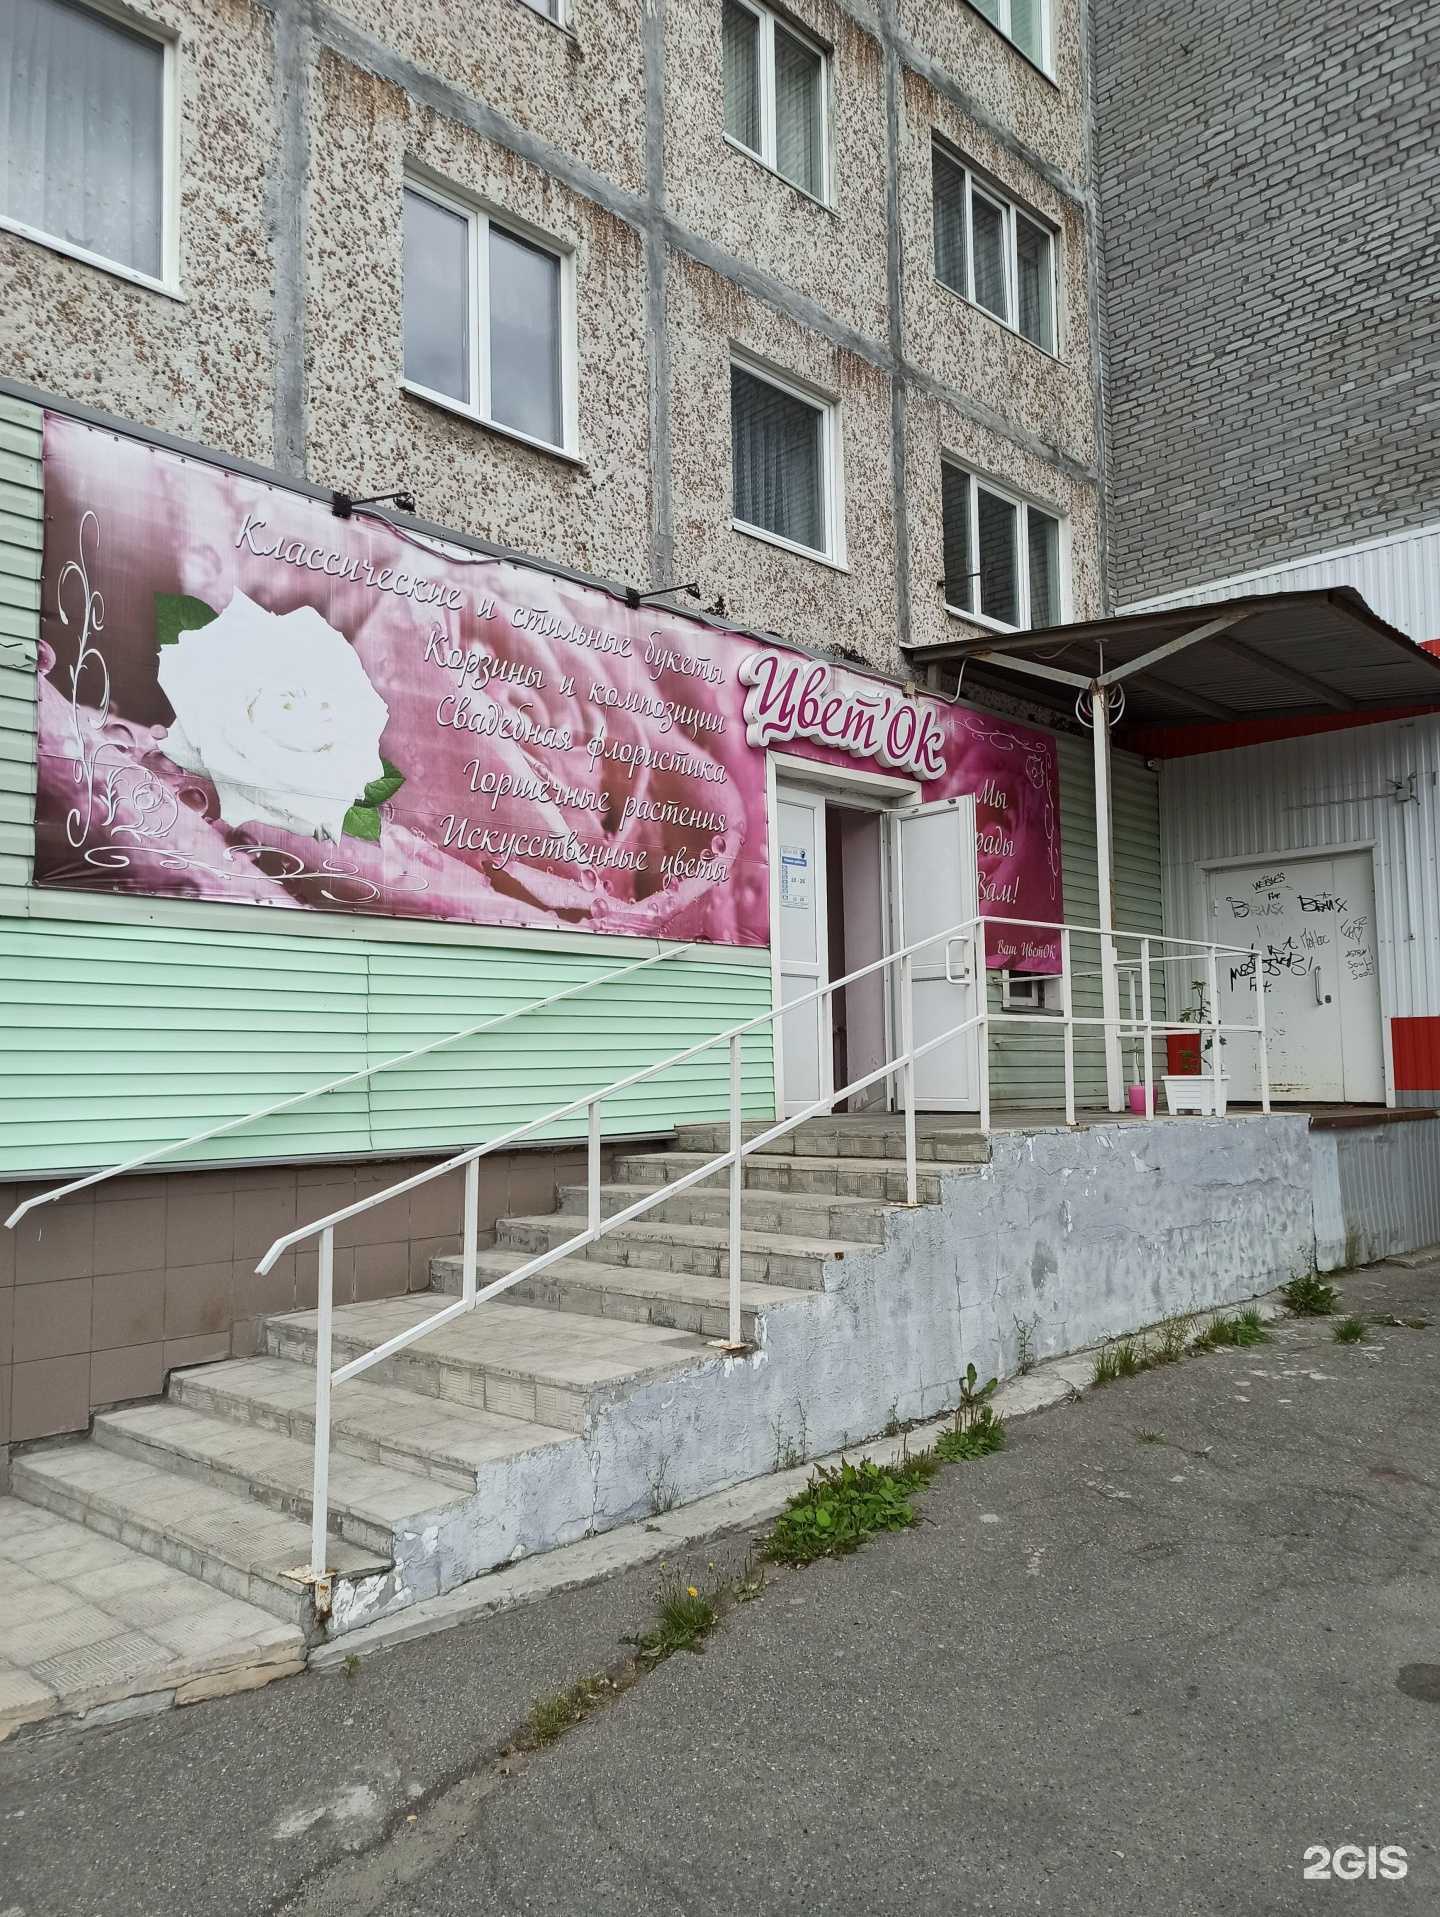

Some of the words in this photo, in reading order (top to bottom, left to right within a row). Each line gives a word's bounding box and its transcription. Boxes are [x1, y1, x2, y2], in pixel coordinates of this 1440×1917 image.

[235, 513, 463, 611] Классические
[477, 599, 497, 619] и
[511, 606, 633, 658] стильные
[644, 630, 726, 684] букеты
[424, 631, 546, 691] Корзины
[559, 676, 577, 698] и
[588, 684, 728, 739] композиции
[436, 694, 574, 751] Свадебная
[587, 725, 728, 785] флористика
[463, 759, 611, 813] Горшечные
[619, 796, 729, 832] растения
[976, 778, 1009, 809] Мы
[440, 815, 649, 871] Искусственные
[660, 847, 730, 889] цветы
[977, 870, 1020, 904] Вам!
[997, 939, 1017, 956] Ваш
